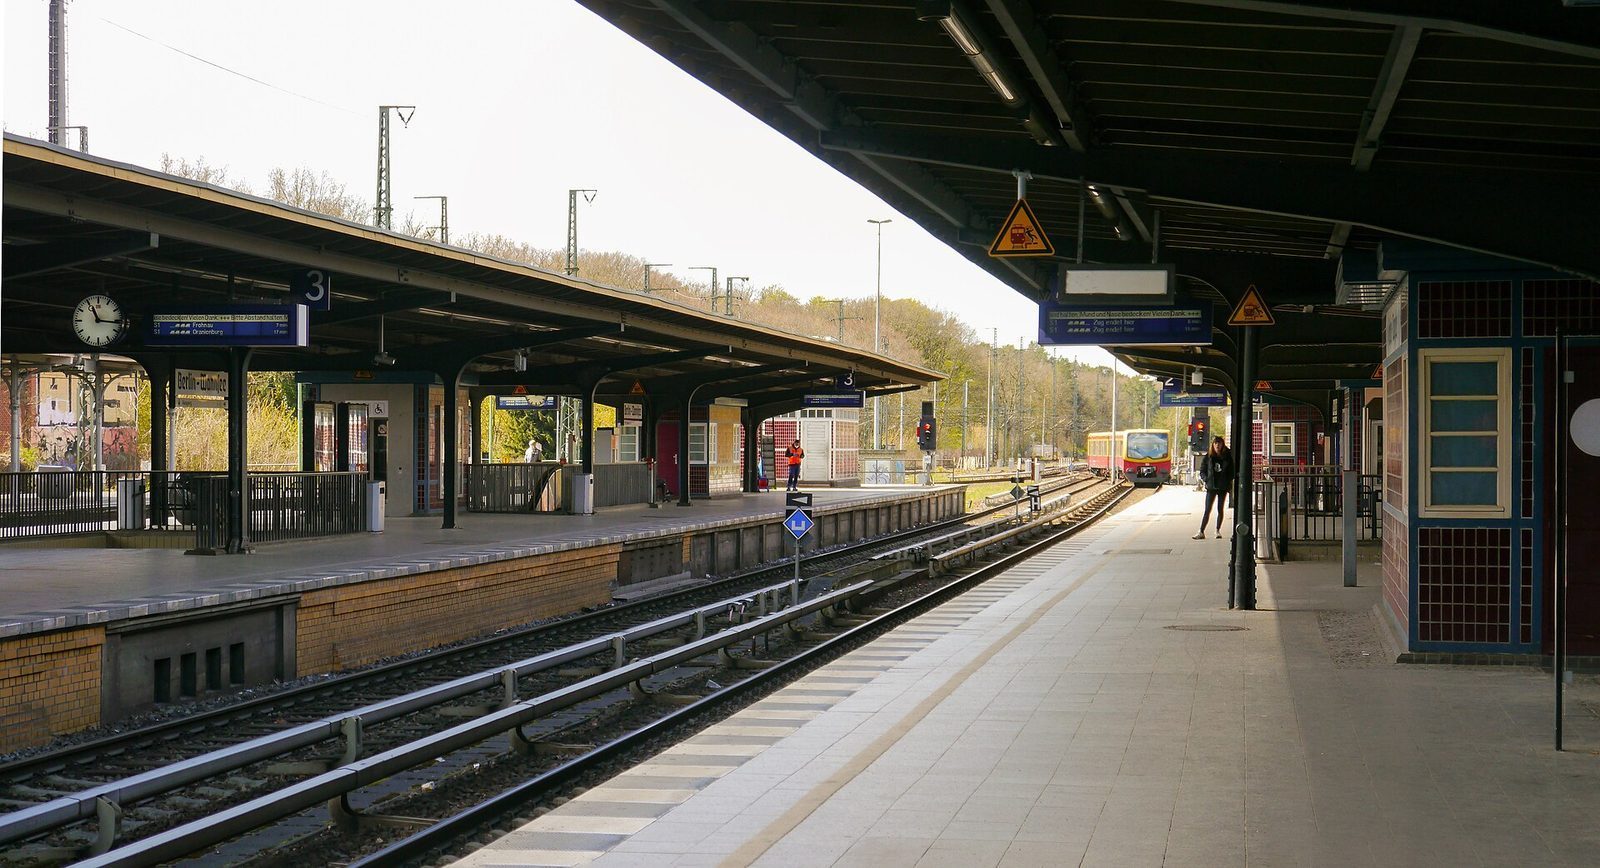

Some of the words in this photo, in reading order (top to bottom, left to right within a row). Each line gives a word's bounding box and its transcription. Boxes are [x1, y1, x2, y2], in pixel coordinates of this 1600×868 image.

[305, 270, 324, 301] 3
[1093, 319, 1104, 327] Zug
[1093, 326, 1104, 334] Zug
[843, 372, 853, 386] 3
[1031, 496, 1041, 510] H
